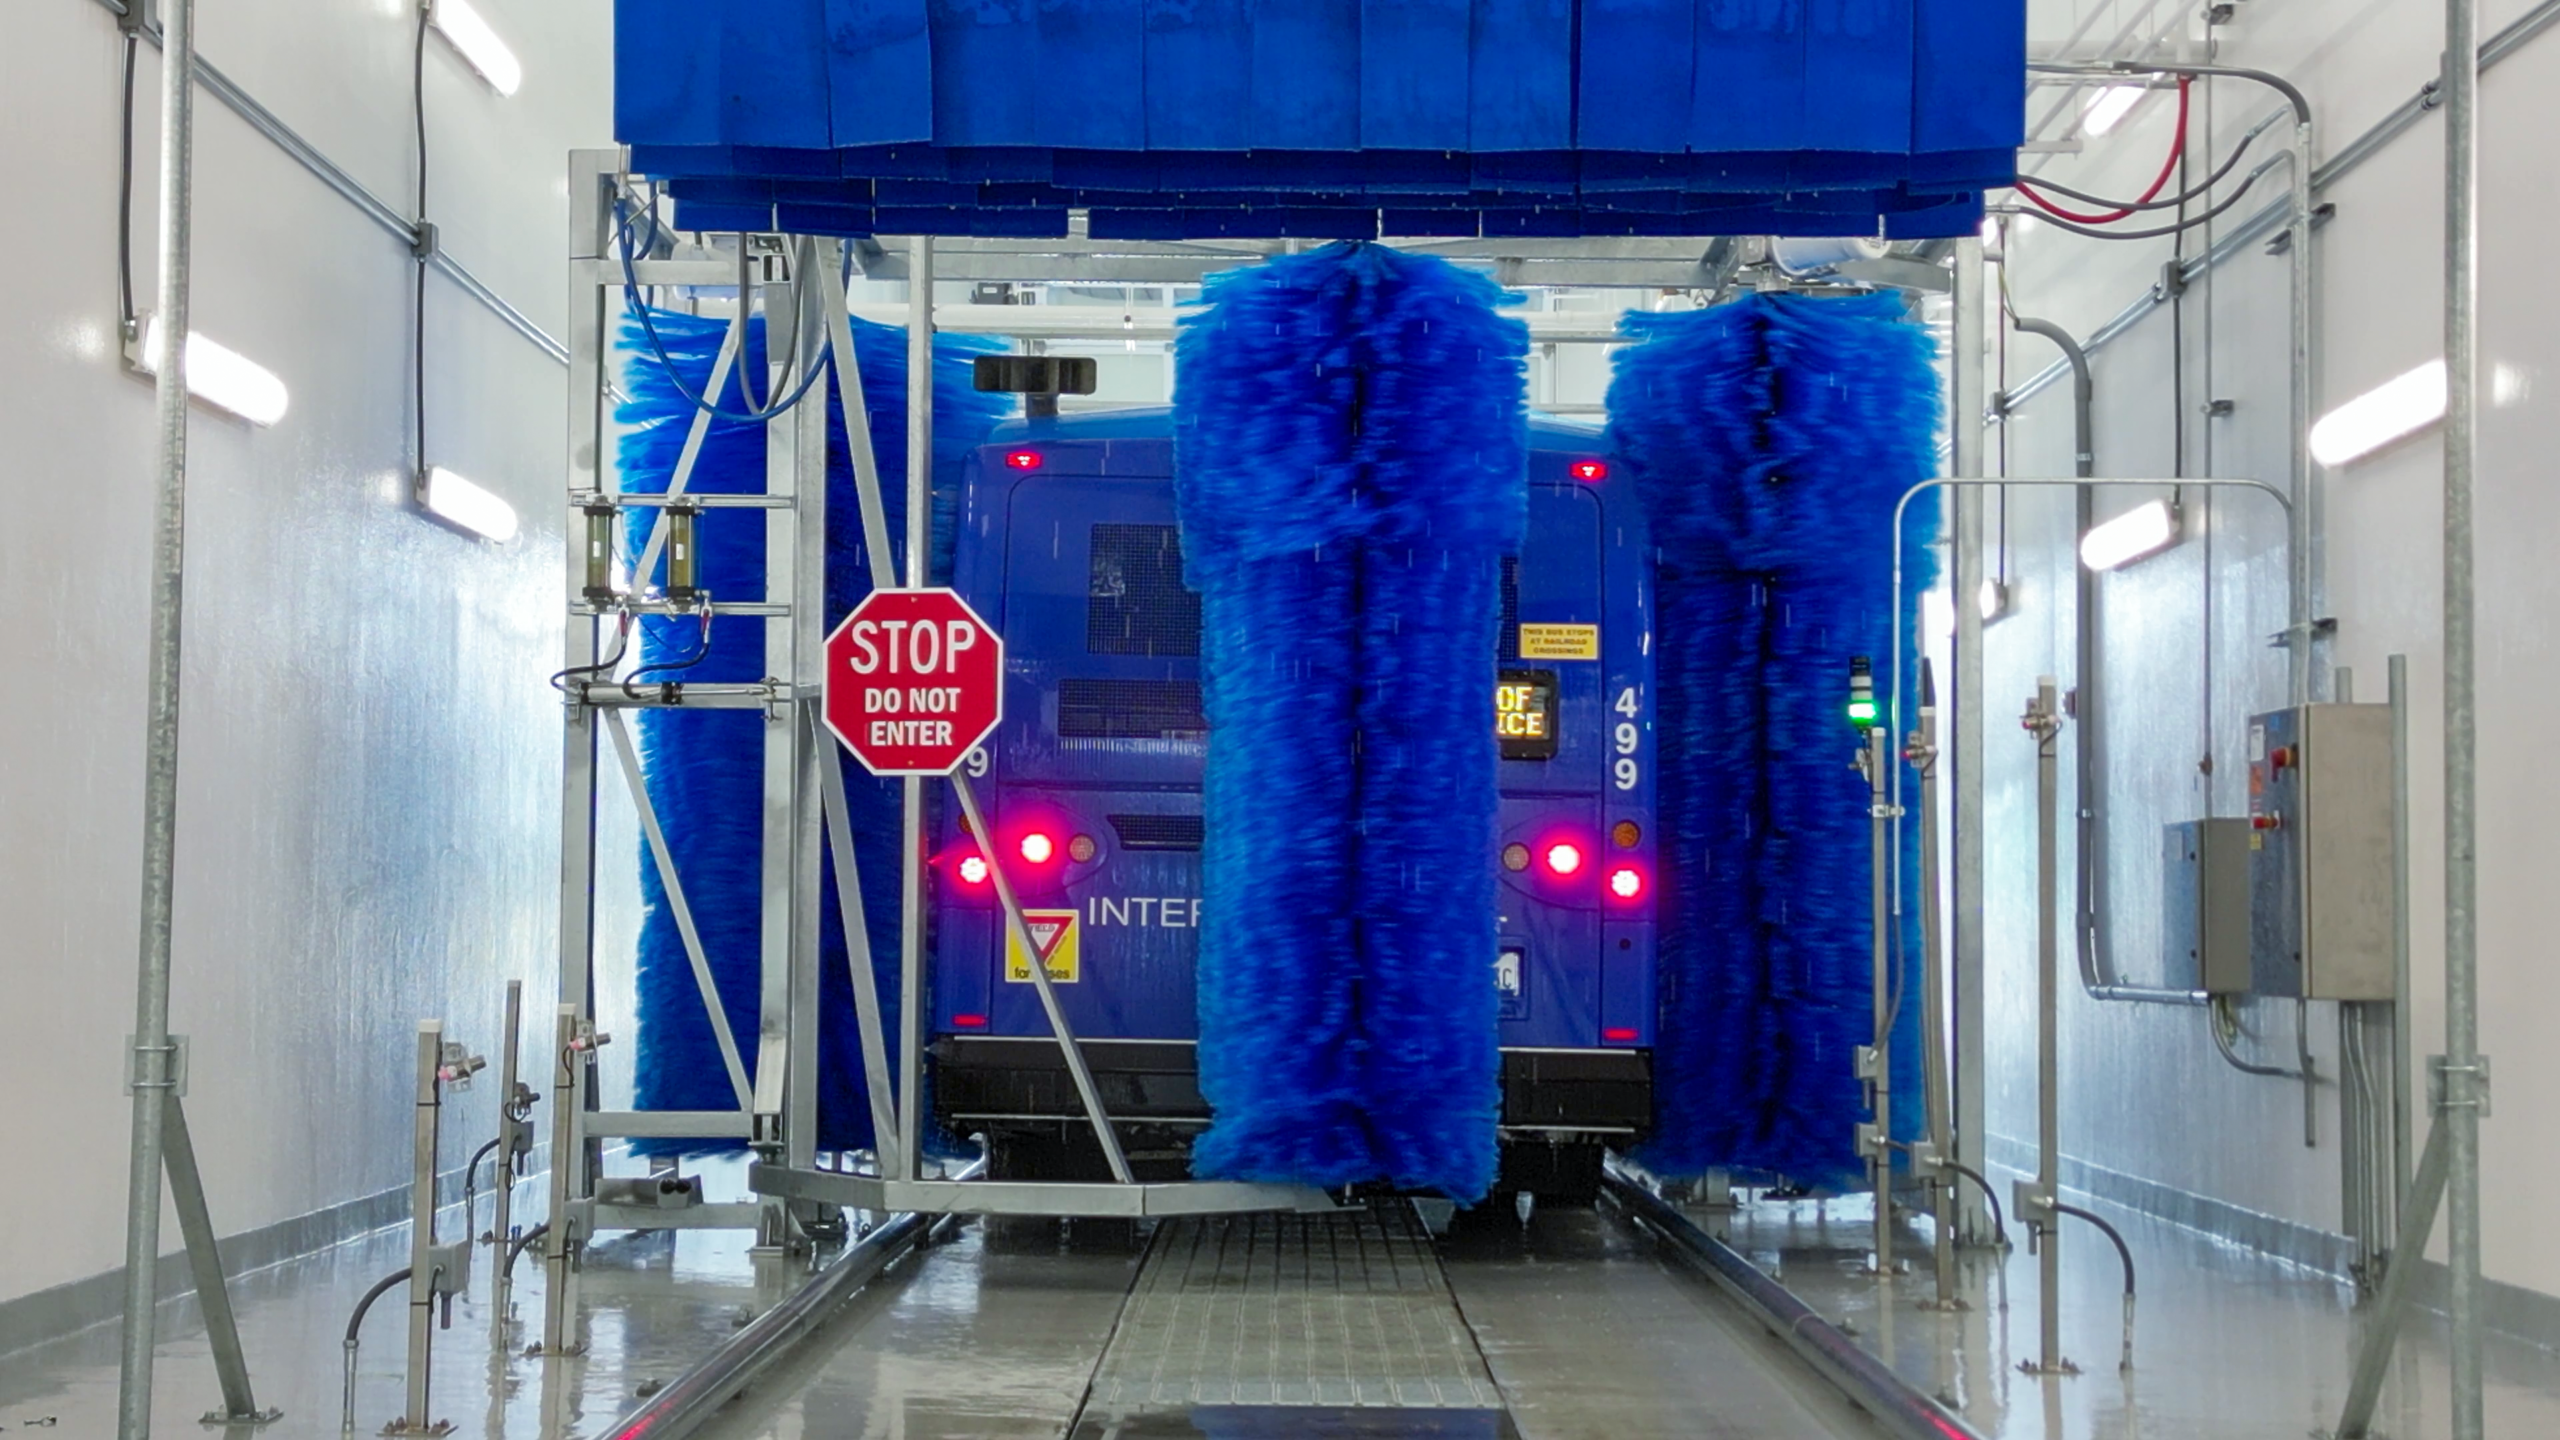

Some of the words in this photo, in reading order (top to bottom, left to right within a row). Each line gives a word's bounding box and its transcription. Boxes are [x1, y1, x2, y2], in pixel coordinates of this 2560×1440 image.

[1543, 638, 1588, 646] RAILROAD
[1546, 628, 1563, 636] BUS
[1566, 629, 1595, 637] STOPS
[850, 619, 976, 675] STOP
[1533, 647, 1584, 655] CROSSINGS
[864, 687, 902, 714] DO
[908, 687, 962, 714] NOT
[1496, 685, 1533, 711] OF
[870, 720, 953, 747] ENTER
[1615, 687, 1638, 791] 499
[1014, 966, 1031, 980] for
